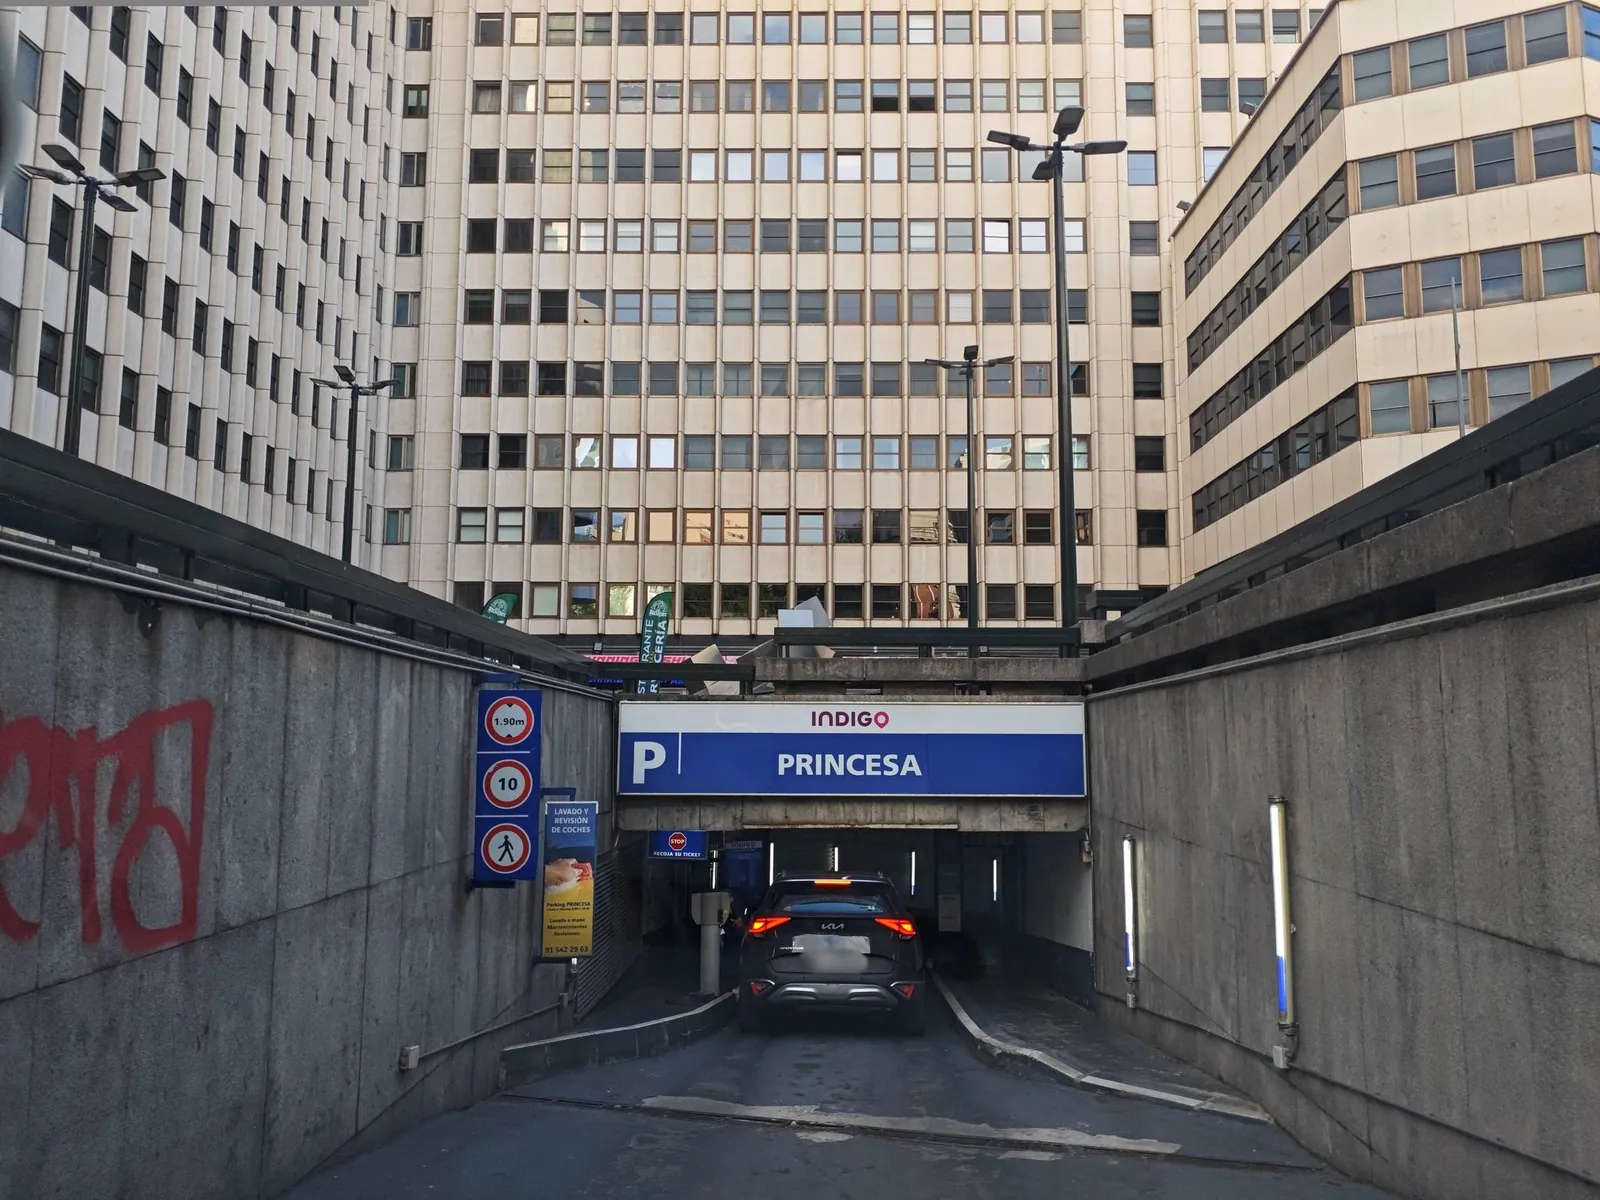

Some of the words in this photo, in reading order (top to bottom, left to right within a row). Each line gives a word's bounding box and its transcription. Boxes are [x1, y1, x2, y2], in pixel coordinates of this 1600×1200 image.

[494, 717, 525, 726] 1.90m
[811, 711, 890, 729] INDIGO
[632, 741, 667, 785] P
[778, 753, 923, 776] PRINCESA
[498, 777, 518, 791] 10
[554, 816, 589, 824] REVISIÓN
[551, 826, 561, 834] DE
[562, 826, 591, 834] COCHES
